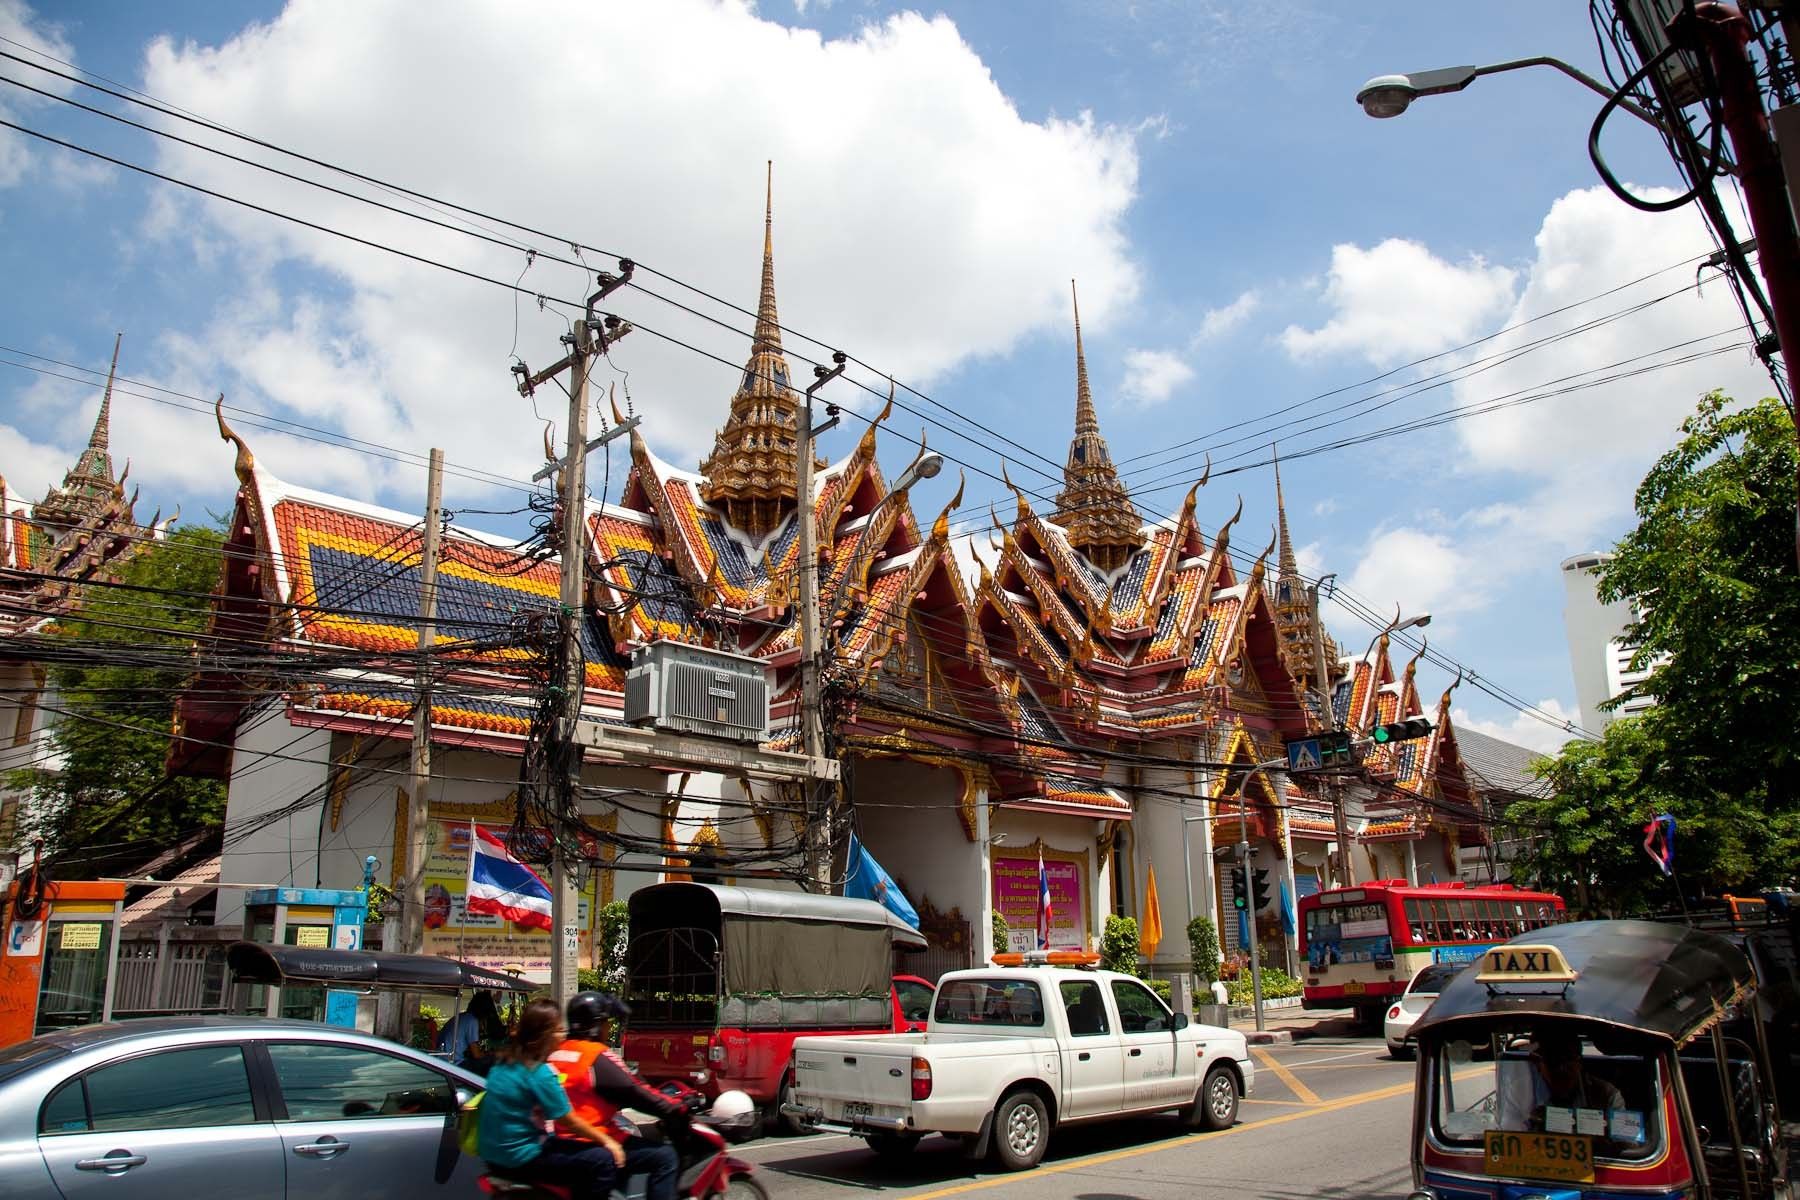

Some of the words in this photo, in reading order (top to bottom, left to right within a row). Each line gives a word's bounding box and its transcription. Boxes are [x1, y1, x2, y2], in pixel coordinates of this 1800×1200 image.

[1012, 932, 1029, 944] เข้า
[1490, 952, 1552, 971] TAXI
[1534, 1136, 1587, 1162] 1593
